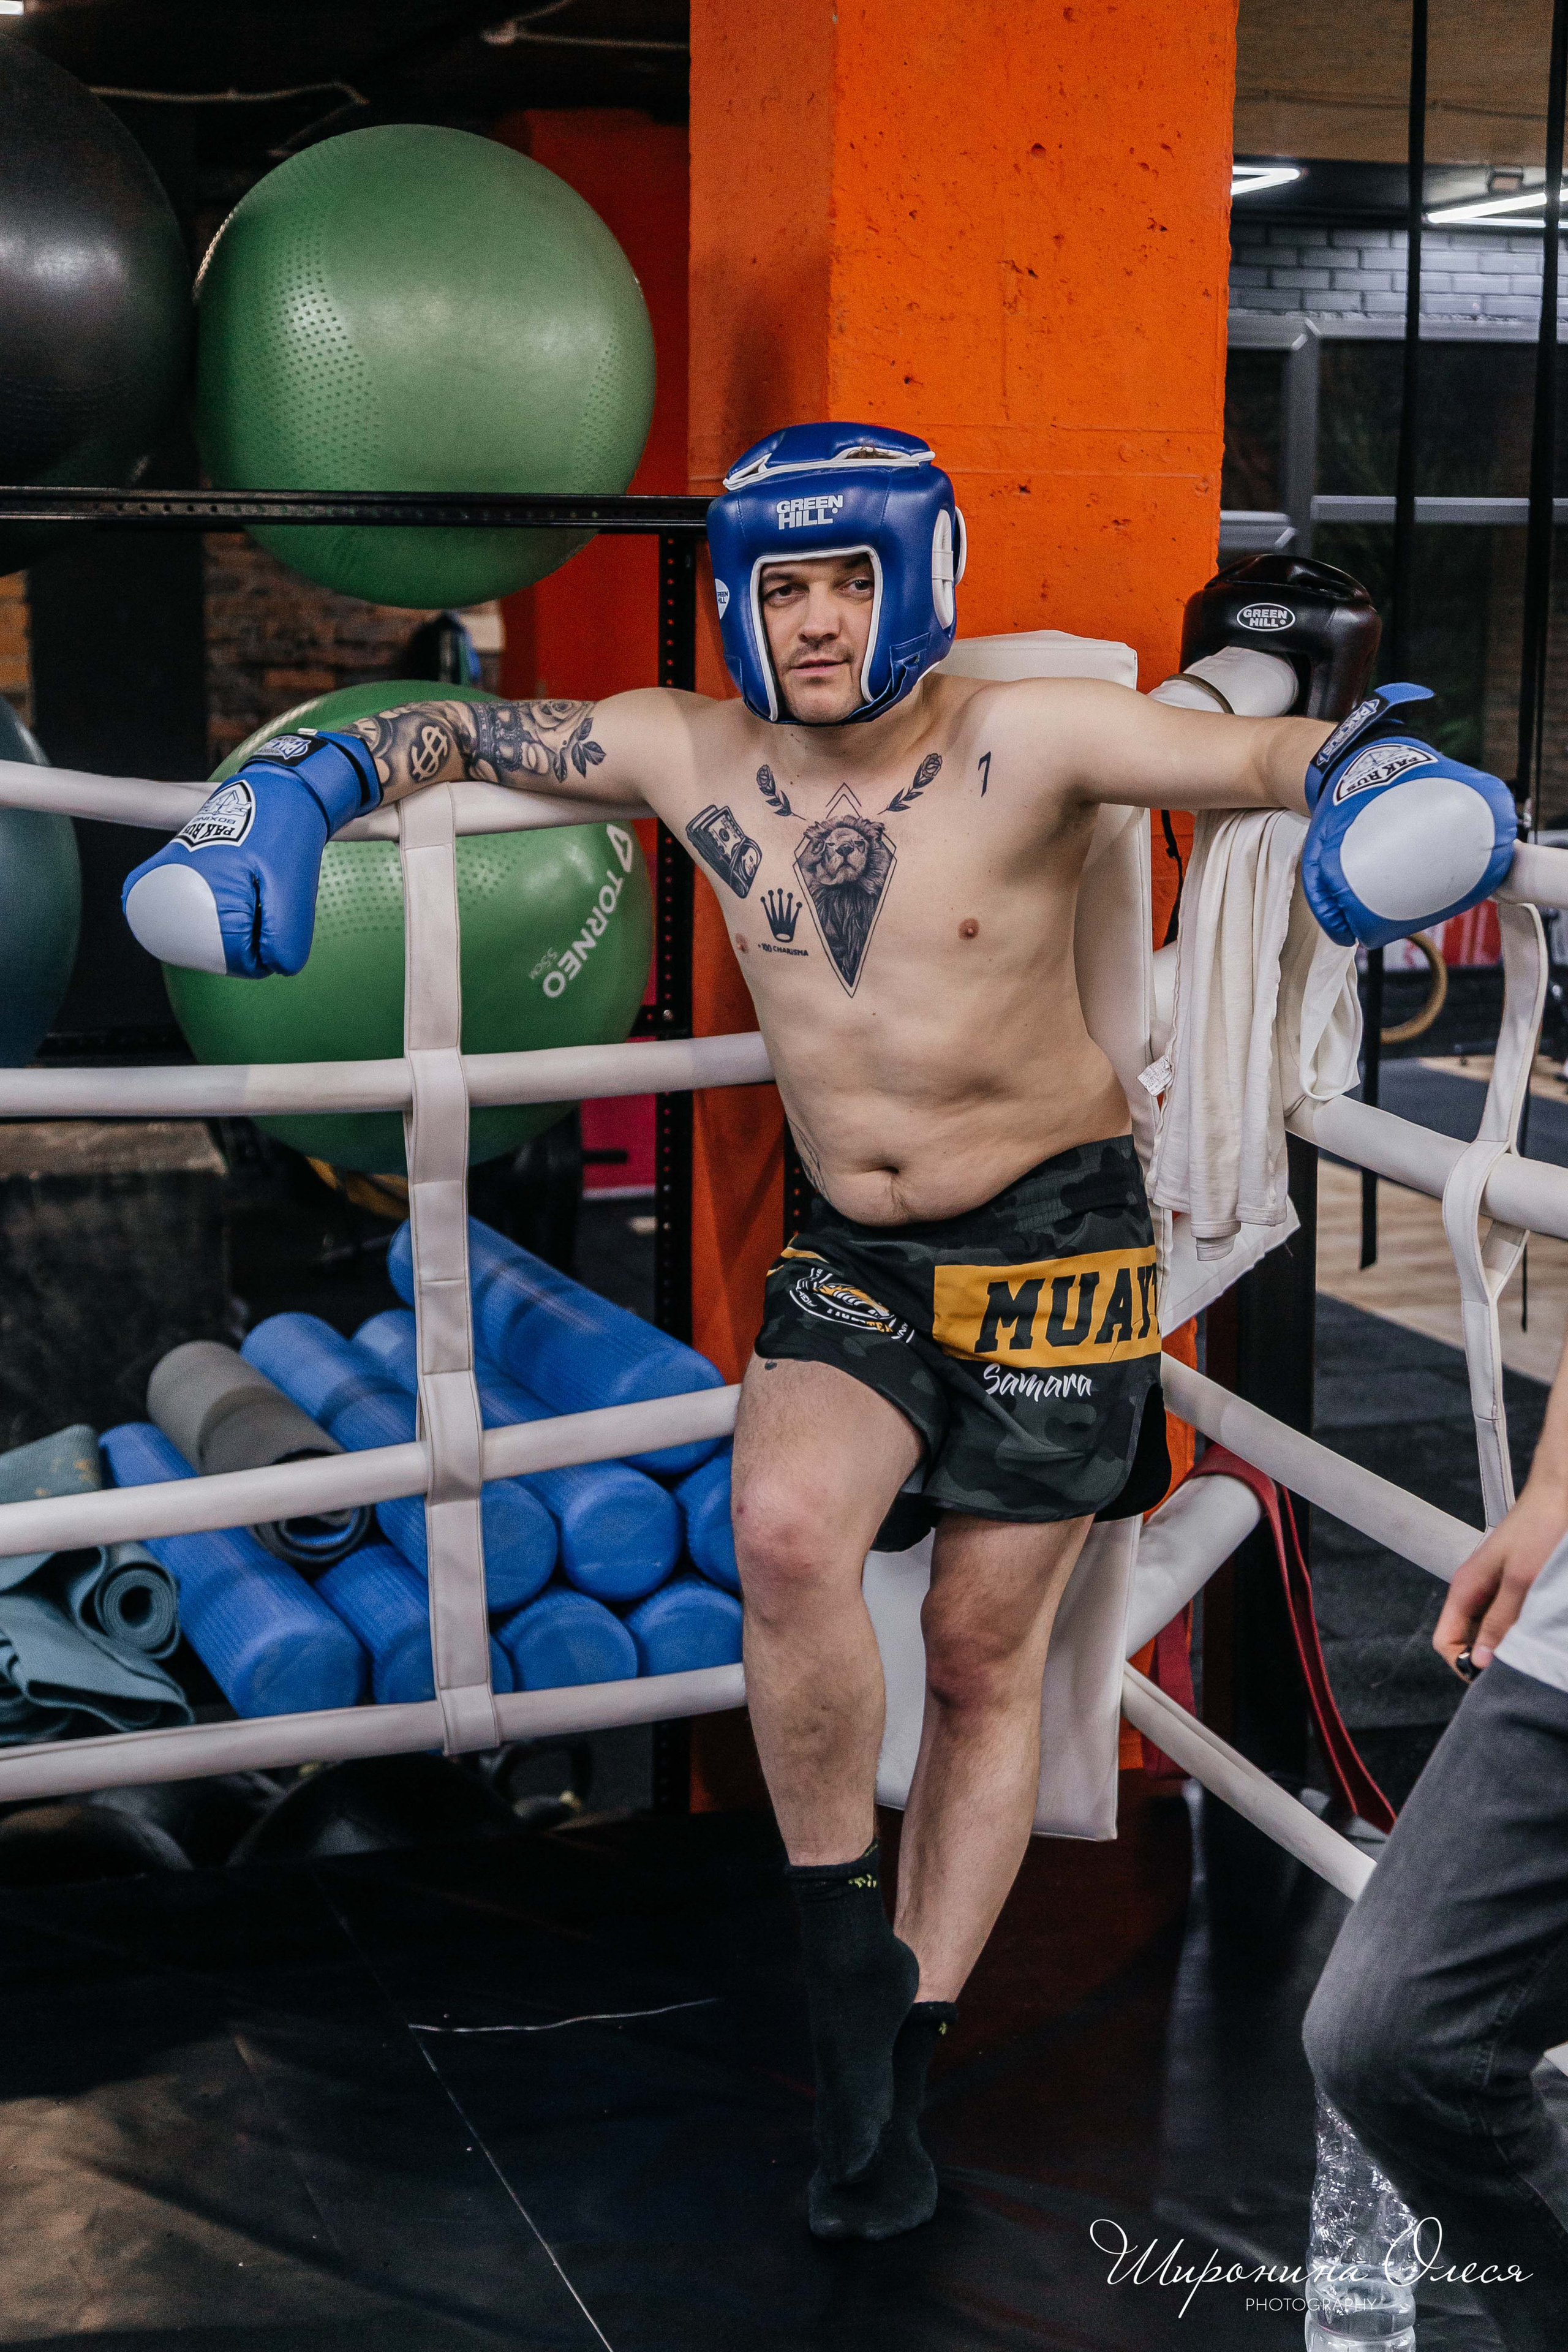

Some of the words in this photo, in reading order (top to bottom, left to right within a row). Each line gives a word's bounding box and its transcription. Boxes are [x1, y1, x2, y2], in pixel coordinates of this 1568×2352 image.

[777, 495, 843, 514] GREEN
[778, 508, 833, 530] HILL
[1243, 609, 1287, 619] GREEN
[1250, 618, 1279, 627] HILL
[1381, 758, 1419, 775] PAK
[1348, 770, 1381, 793] RUS
[198, 823, 236, 840] PAK
[543, 870, 624, 998] TORNEO
[983, 1363, 1092, 1402] Samara
